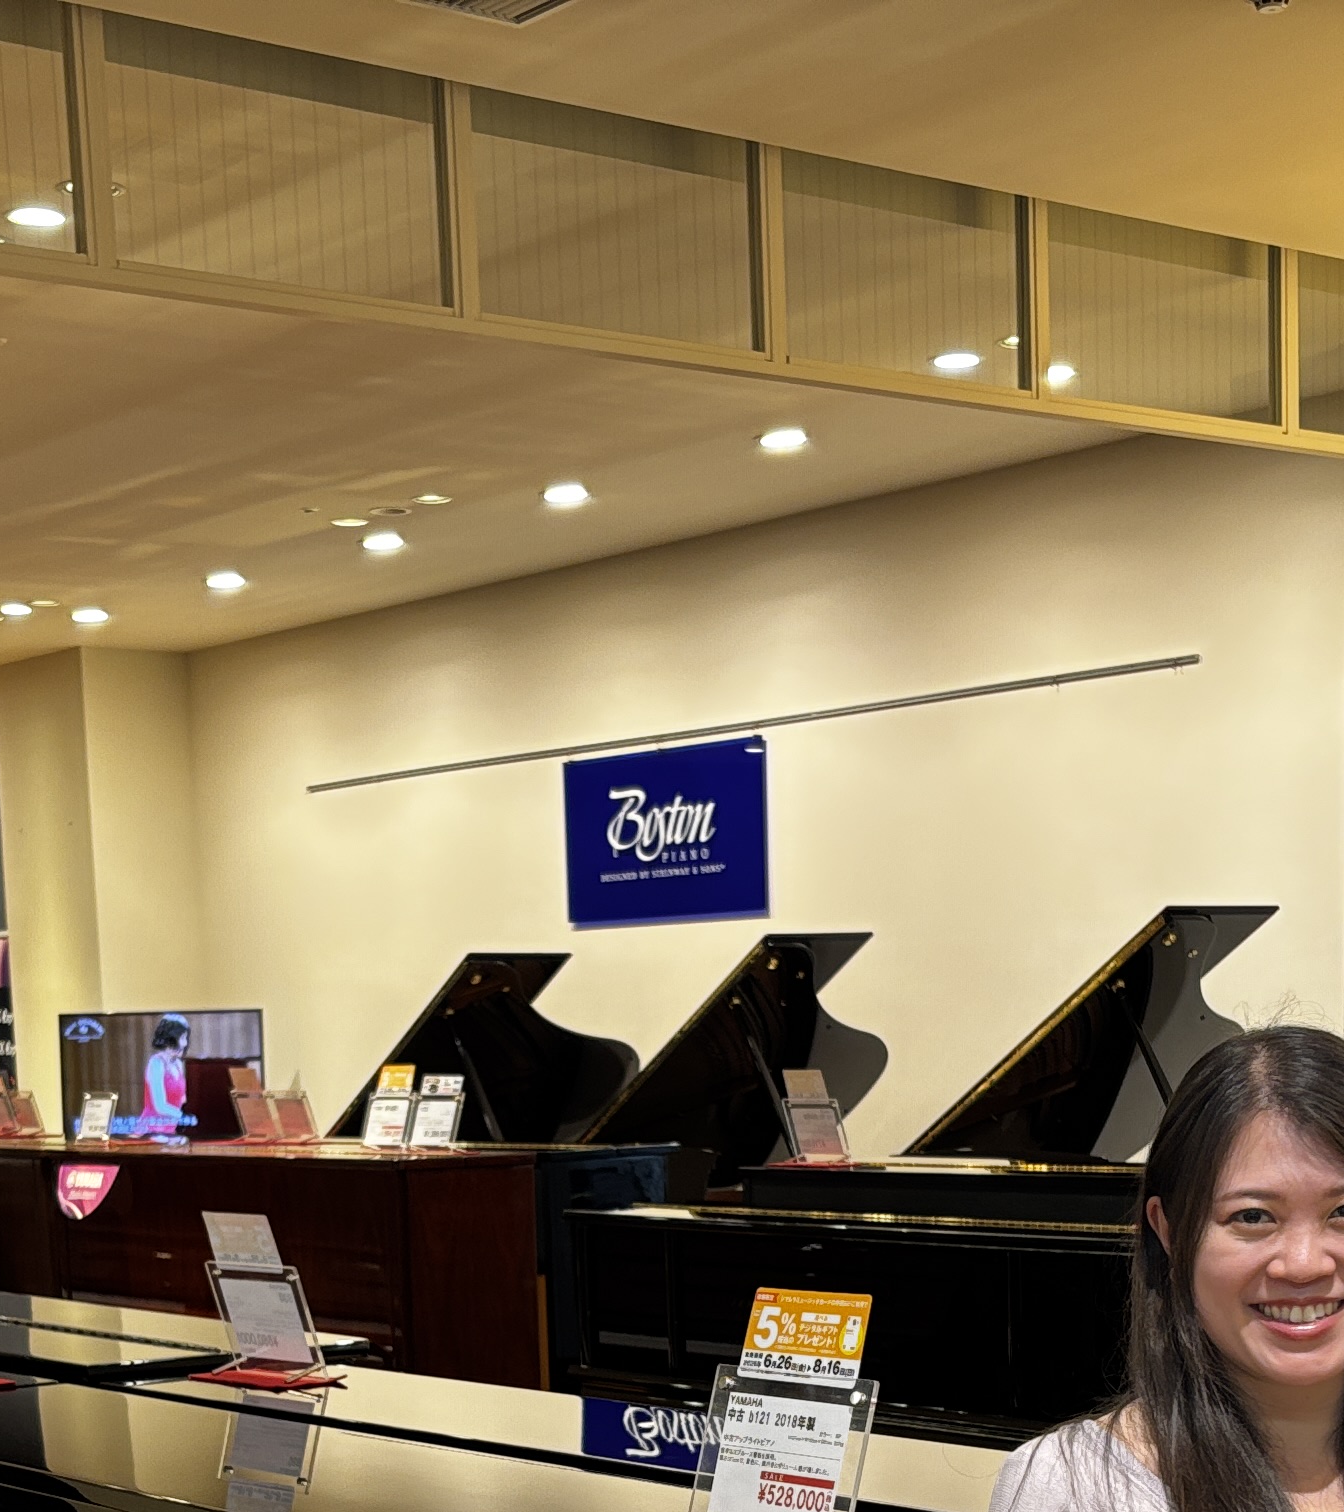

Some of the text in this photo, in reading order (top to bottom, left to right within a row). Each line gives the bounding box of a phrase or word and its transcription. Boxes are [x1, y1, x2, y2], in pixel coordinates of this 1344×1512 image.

[607, 788, 717, 862] Boston
[661, 848, 710, 863] PIANO
[730, 1395, 763, 1408] YAMAHA
[727, 1406, 816, 1431] 中古 b121 2018年製
[763, 1472, 784, 1482] SALE
[757, 1482, 825, 1512] ¥528,000
